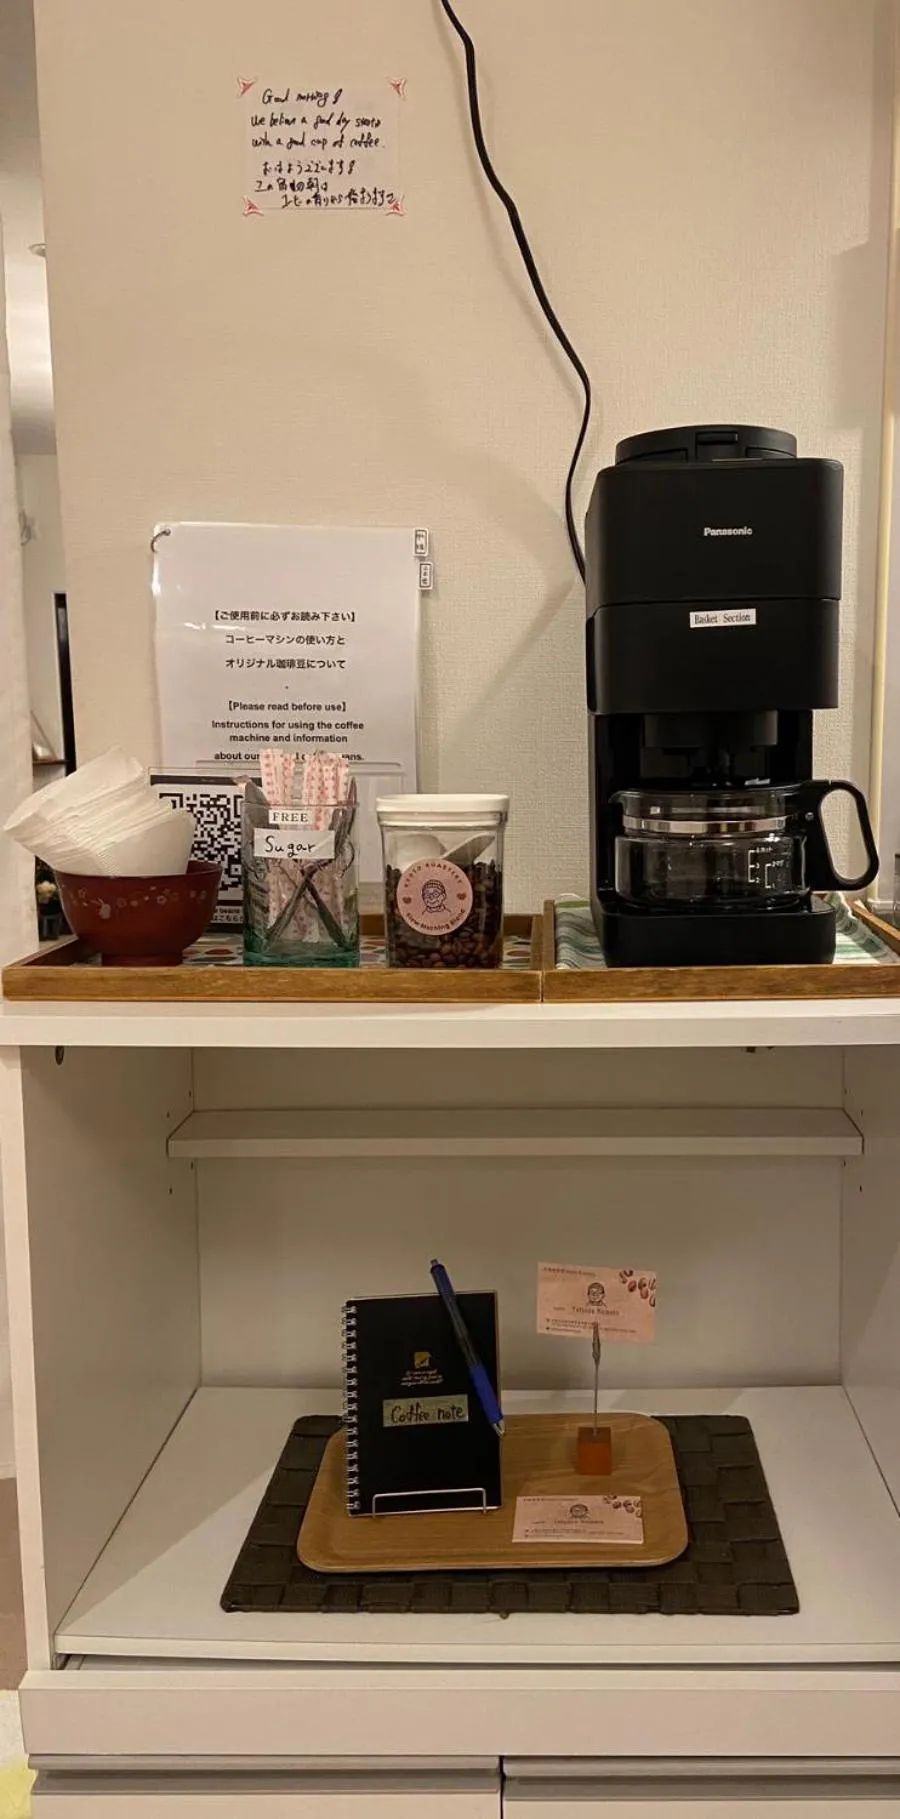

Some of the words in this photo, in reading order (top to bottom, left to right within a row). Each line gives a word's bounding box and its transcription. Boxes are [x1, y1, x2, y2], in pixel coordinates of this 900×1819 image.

[262, 88, 290, 105] Good
[251, 132, 272, 147] with
[311, 138, 328, 150] cup
[704, 526, 752, 536] Panasonic
[694, 614, 718, 625] Basket
[723, 612, 751, 624] Section
[225, 634, 346, 645] コーヒーマシンの使い方と
[225, 658, 346, 669] オリジナル珈琲豆について
[268, 701, 289, 711] read
[292, 701, 322, 711] before
[212, 720, 269, 729] Instructions
[272, 720, 285, 729] for
[288, 721, 315, 731] using
[317, 721, 332, 730] the
[335, 721, 364, 730] coffee
[229, 734, 270, 742] machine
[273, 734, 290, 742] and
[293, 734, 348, 743] information
[214, 752, 242, 760] about
[272, 812, 309, 823] FREE
[265, 835, 316, 857] Sugar
[391, 1402, 430, 1424] Coffee
[437, 1404, 464, 1421] note
